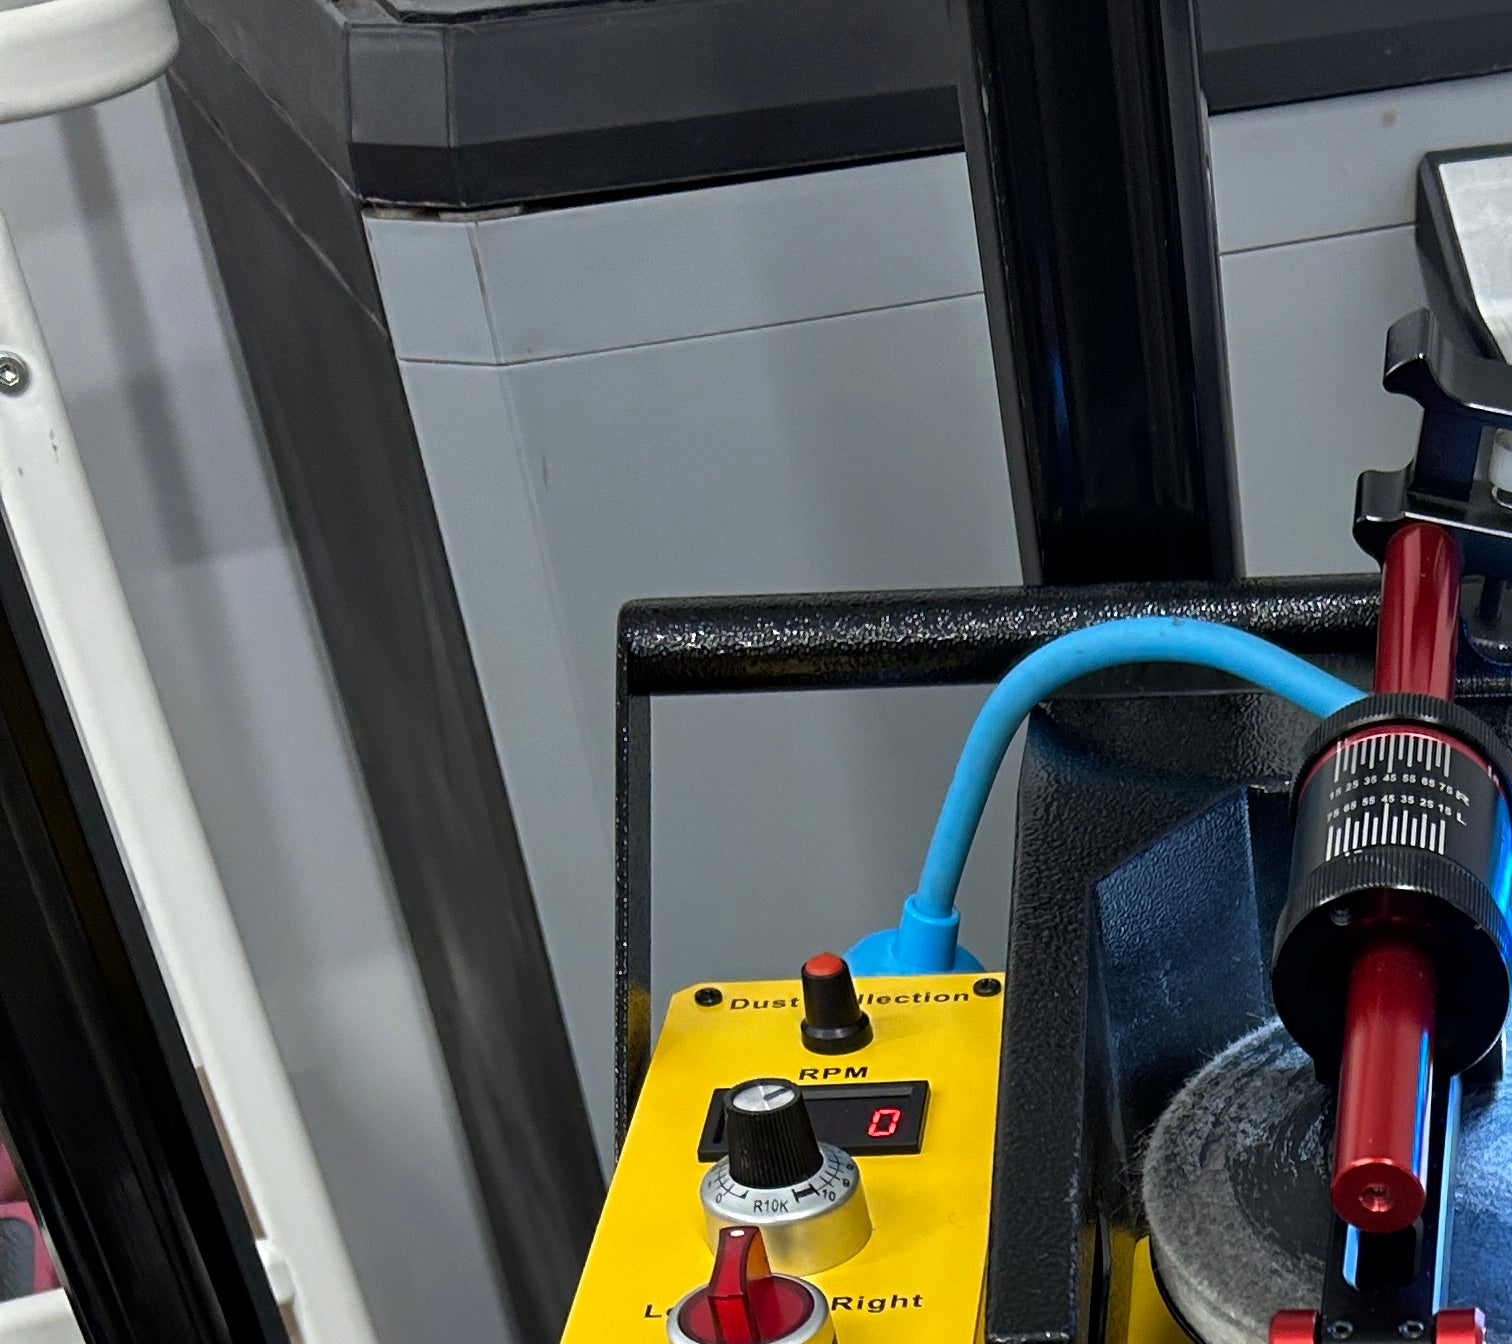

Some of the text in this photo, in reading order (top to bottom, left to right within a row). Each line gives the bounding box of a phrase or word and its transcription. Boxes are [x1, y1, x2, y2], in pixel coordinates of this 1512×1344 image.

[1363, 775, 1378, 785] 35
[1382, 773, 1397, 782] 45
[1402, 773, 1416, 783] 55
[1381, 794, 1396, 804] 45
[1400, 794, 1414, 804] 35
[1419, 798, 1434, 809] 25
[730, 992, 968, 1010] Dust llection
[798, 1066, 869, 1081] RPM
[867, 1107, 901, 1138] 0
[753, 1199, 789, 1213] R10K
[822, 1188, 836, 1202] 10
[831, 1293, 924, 1313] Right
